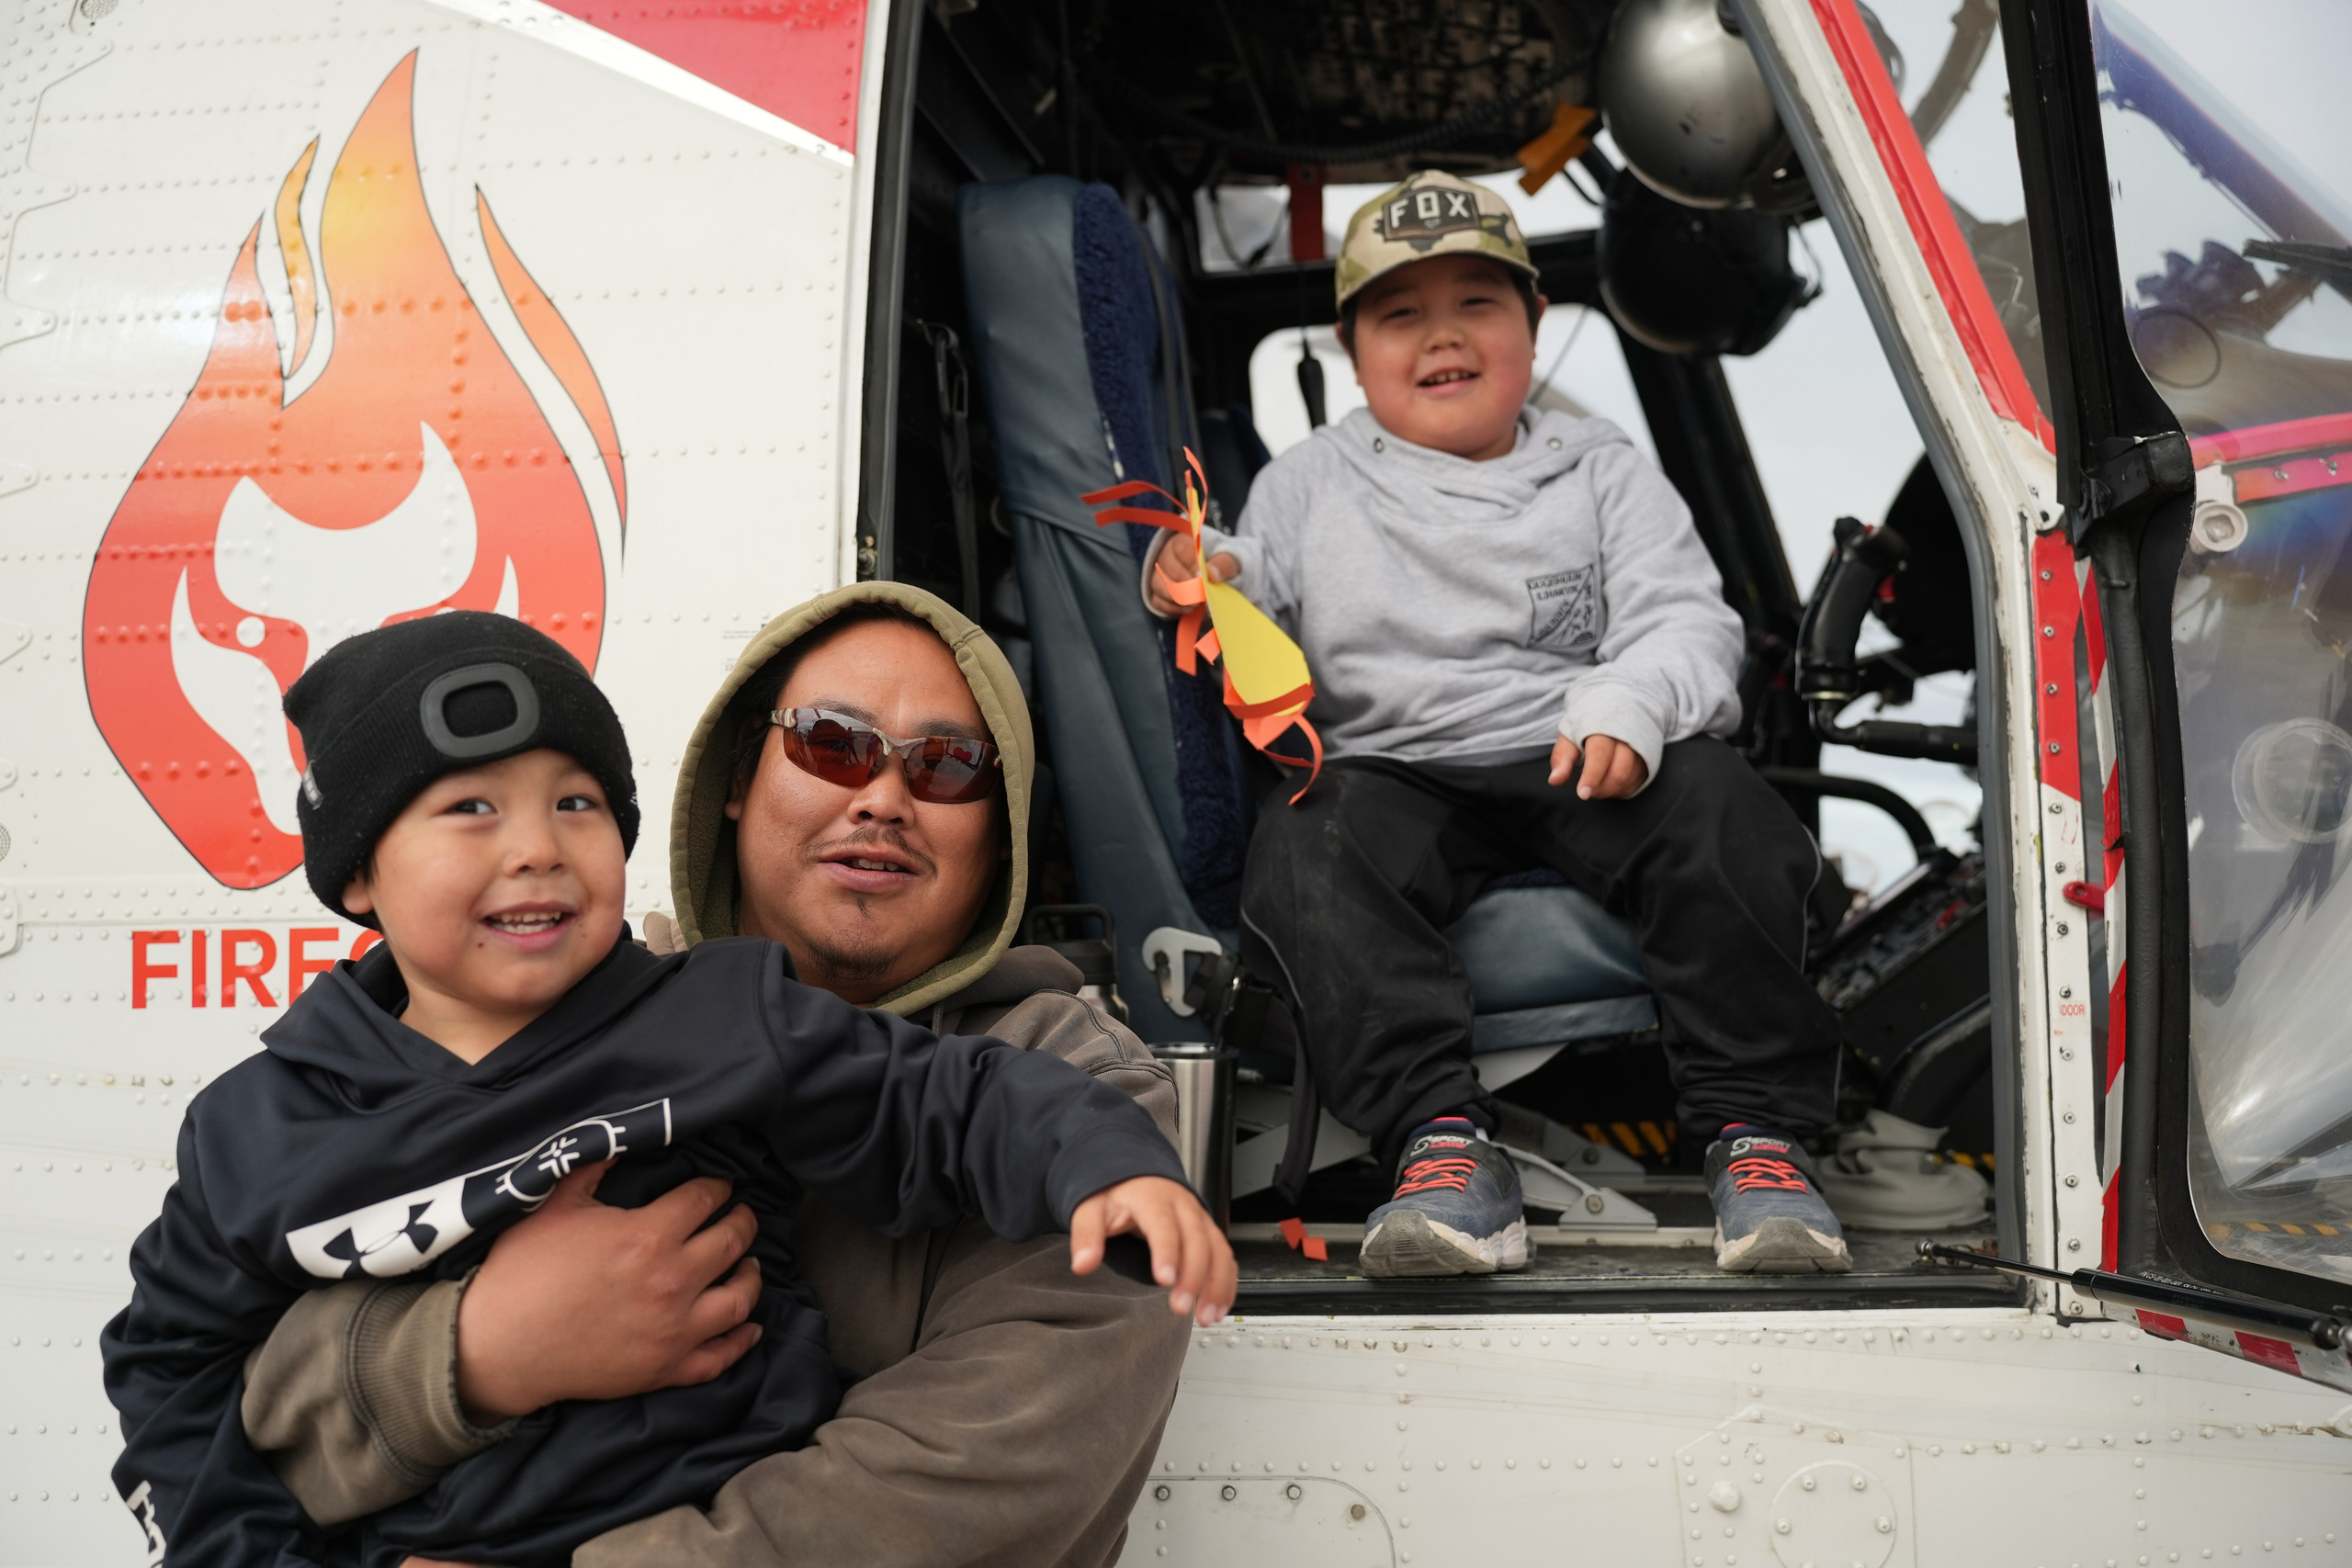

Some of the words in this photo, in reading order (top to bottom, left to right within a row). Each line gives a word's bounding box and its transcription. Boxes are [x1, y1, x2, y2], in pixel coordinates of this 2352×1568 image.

[1389, 191, 1471, 229] FOX
[131, 927, 384, 1009] FIRE
[2061, 1003, 2086, 1016] DOOR
[1430, 1134, 1475, 1145] SPORT
[1751, 1136, 1792, 1149] SPORT
